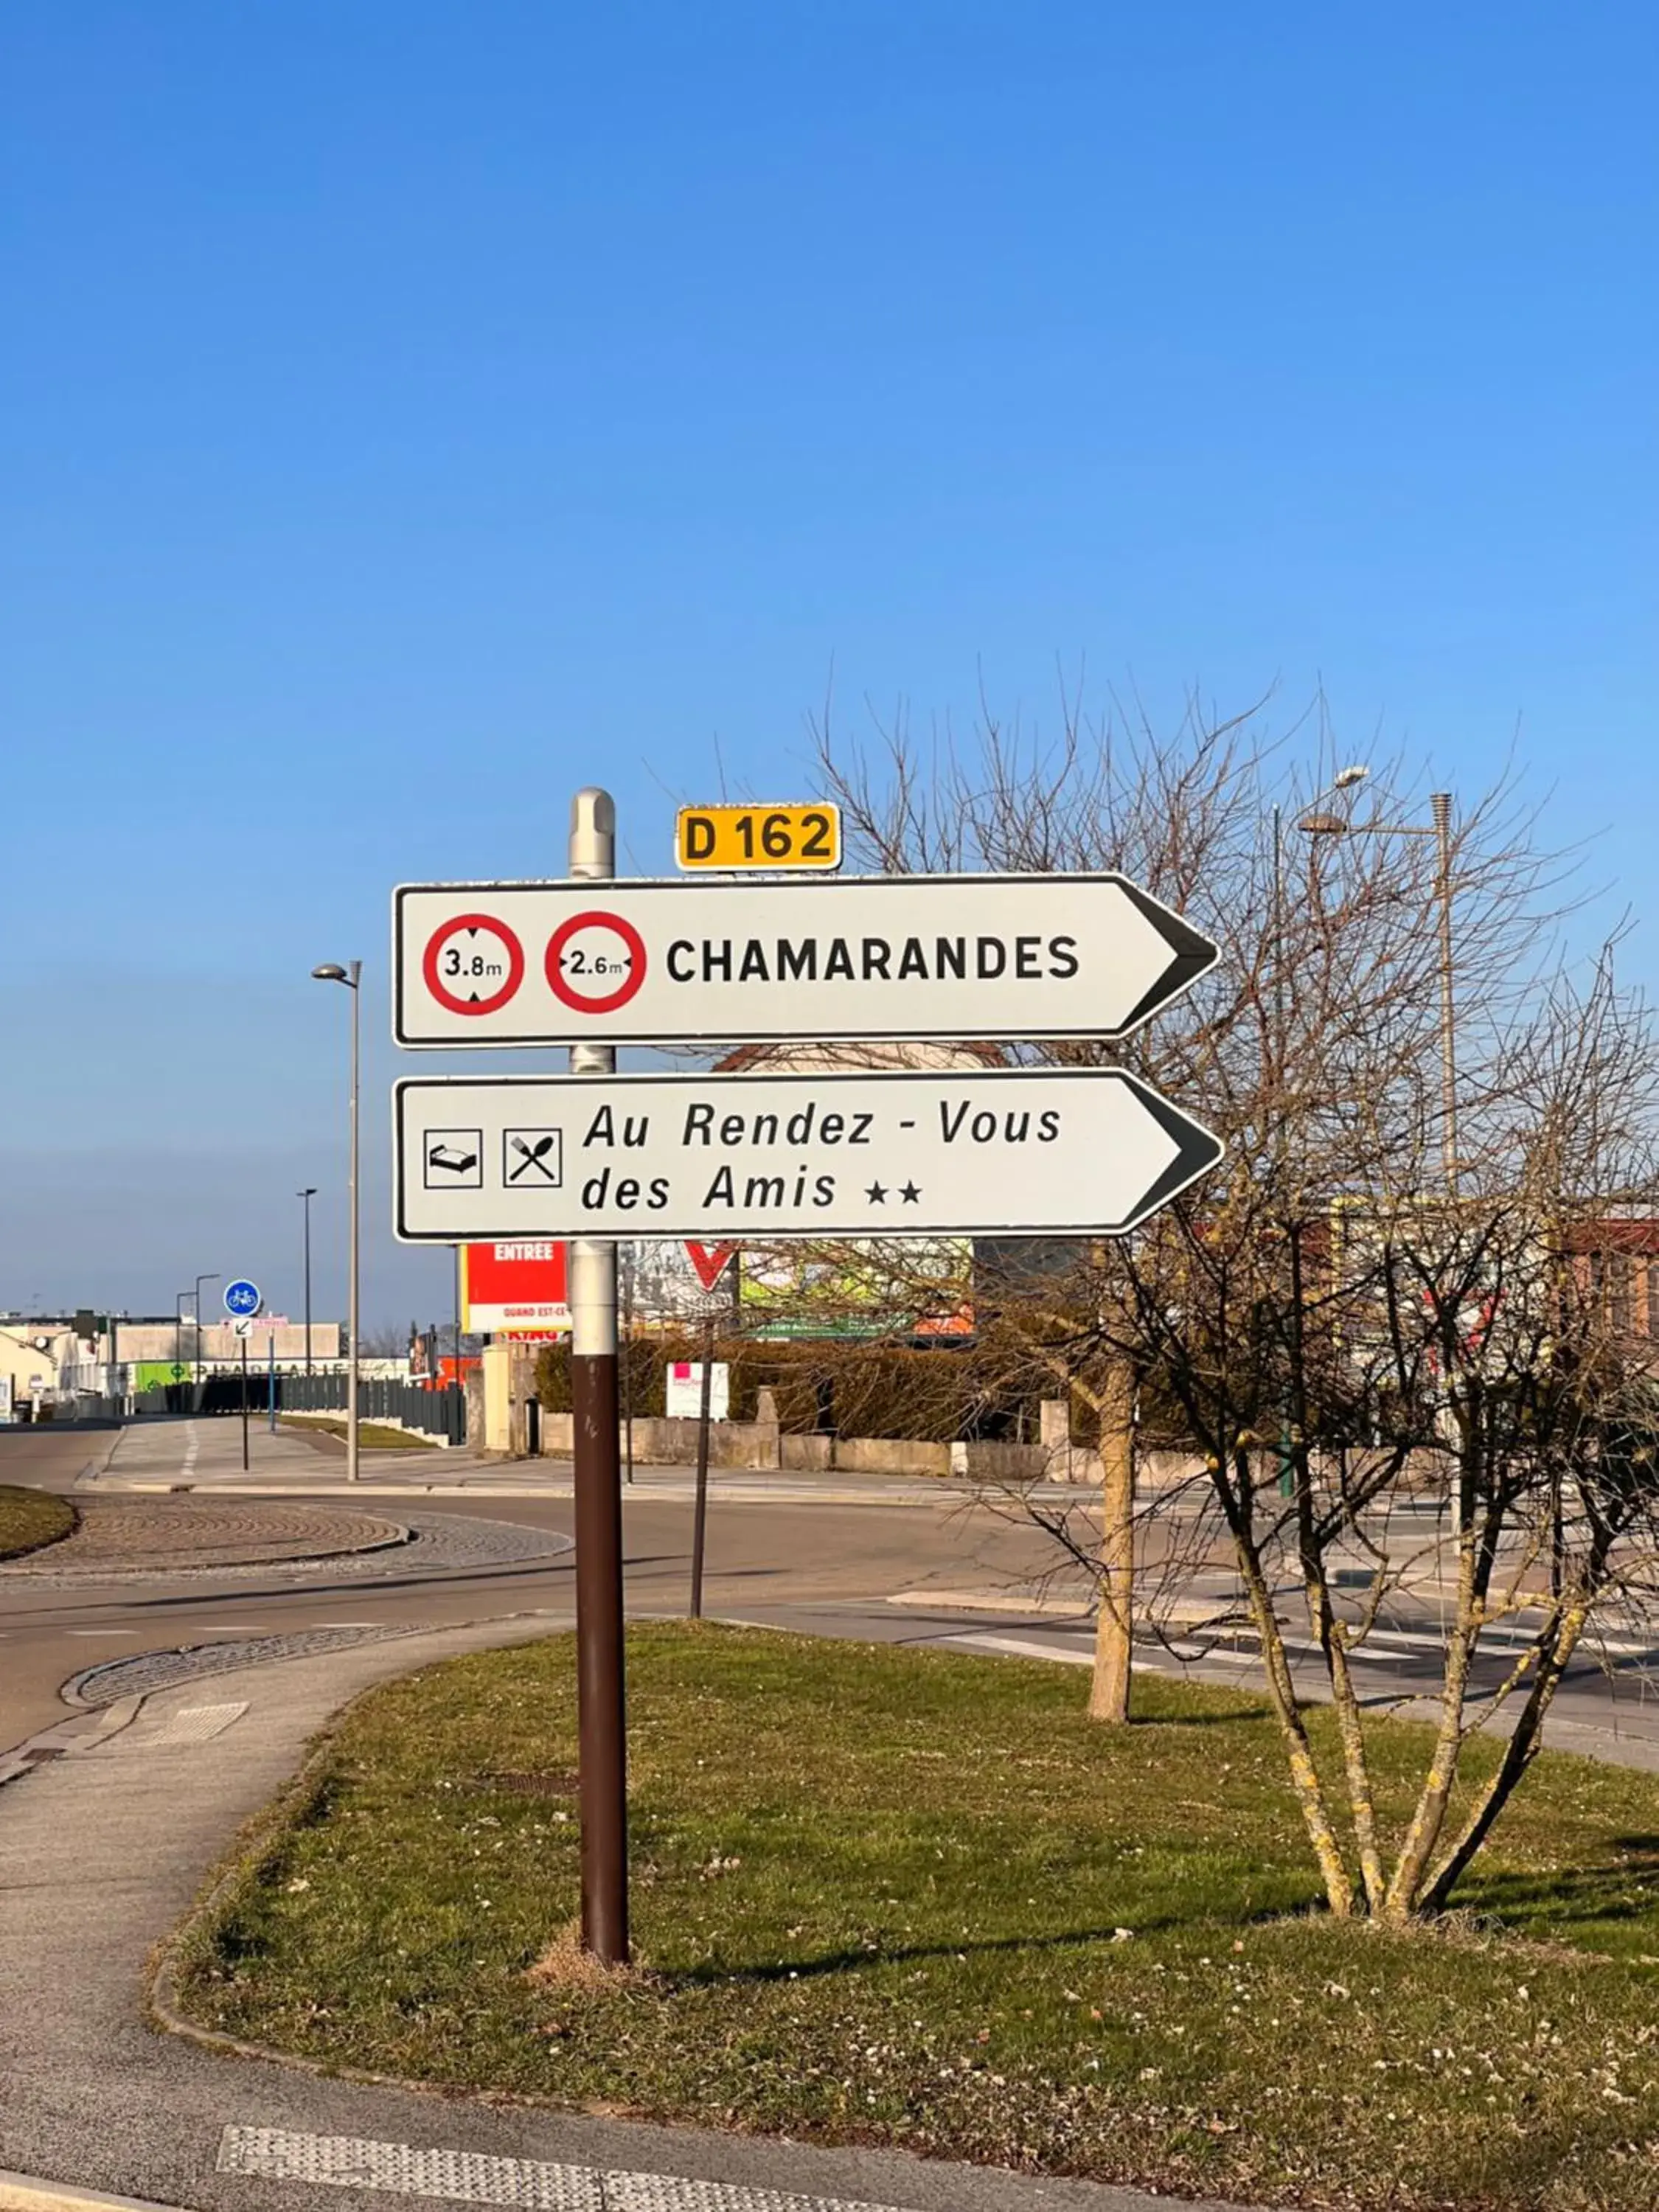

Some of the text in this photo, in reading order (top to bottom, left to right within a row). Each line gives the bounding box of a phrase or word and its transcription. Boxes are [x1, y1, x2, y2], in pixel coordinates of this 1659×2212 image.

[686, 813, 832, 860] D 162
[667, 936, 1079, 983] CHAMARANDES
[582, 1105, 650, 1148] Au
[682, 1102, 874, 1147] Rendez
[939, 1100, 1060, 1144] Vous
[581, 1164, 835, 1211] des Amis
